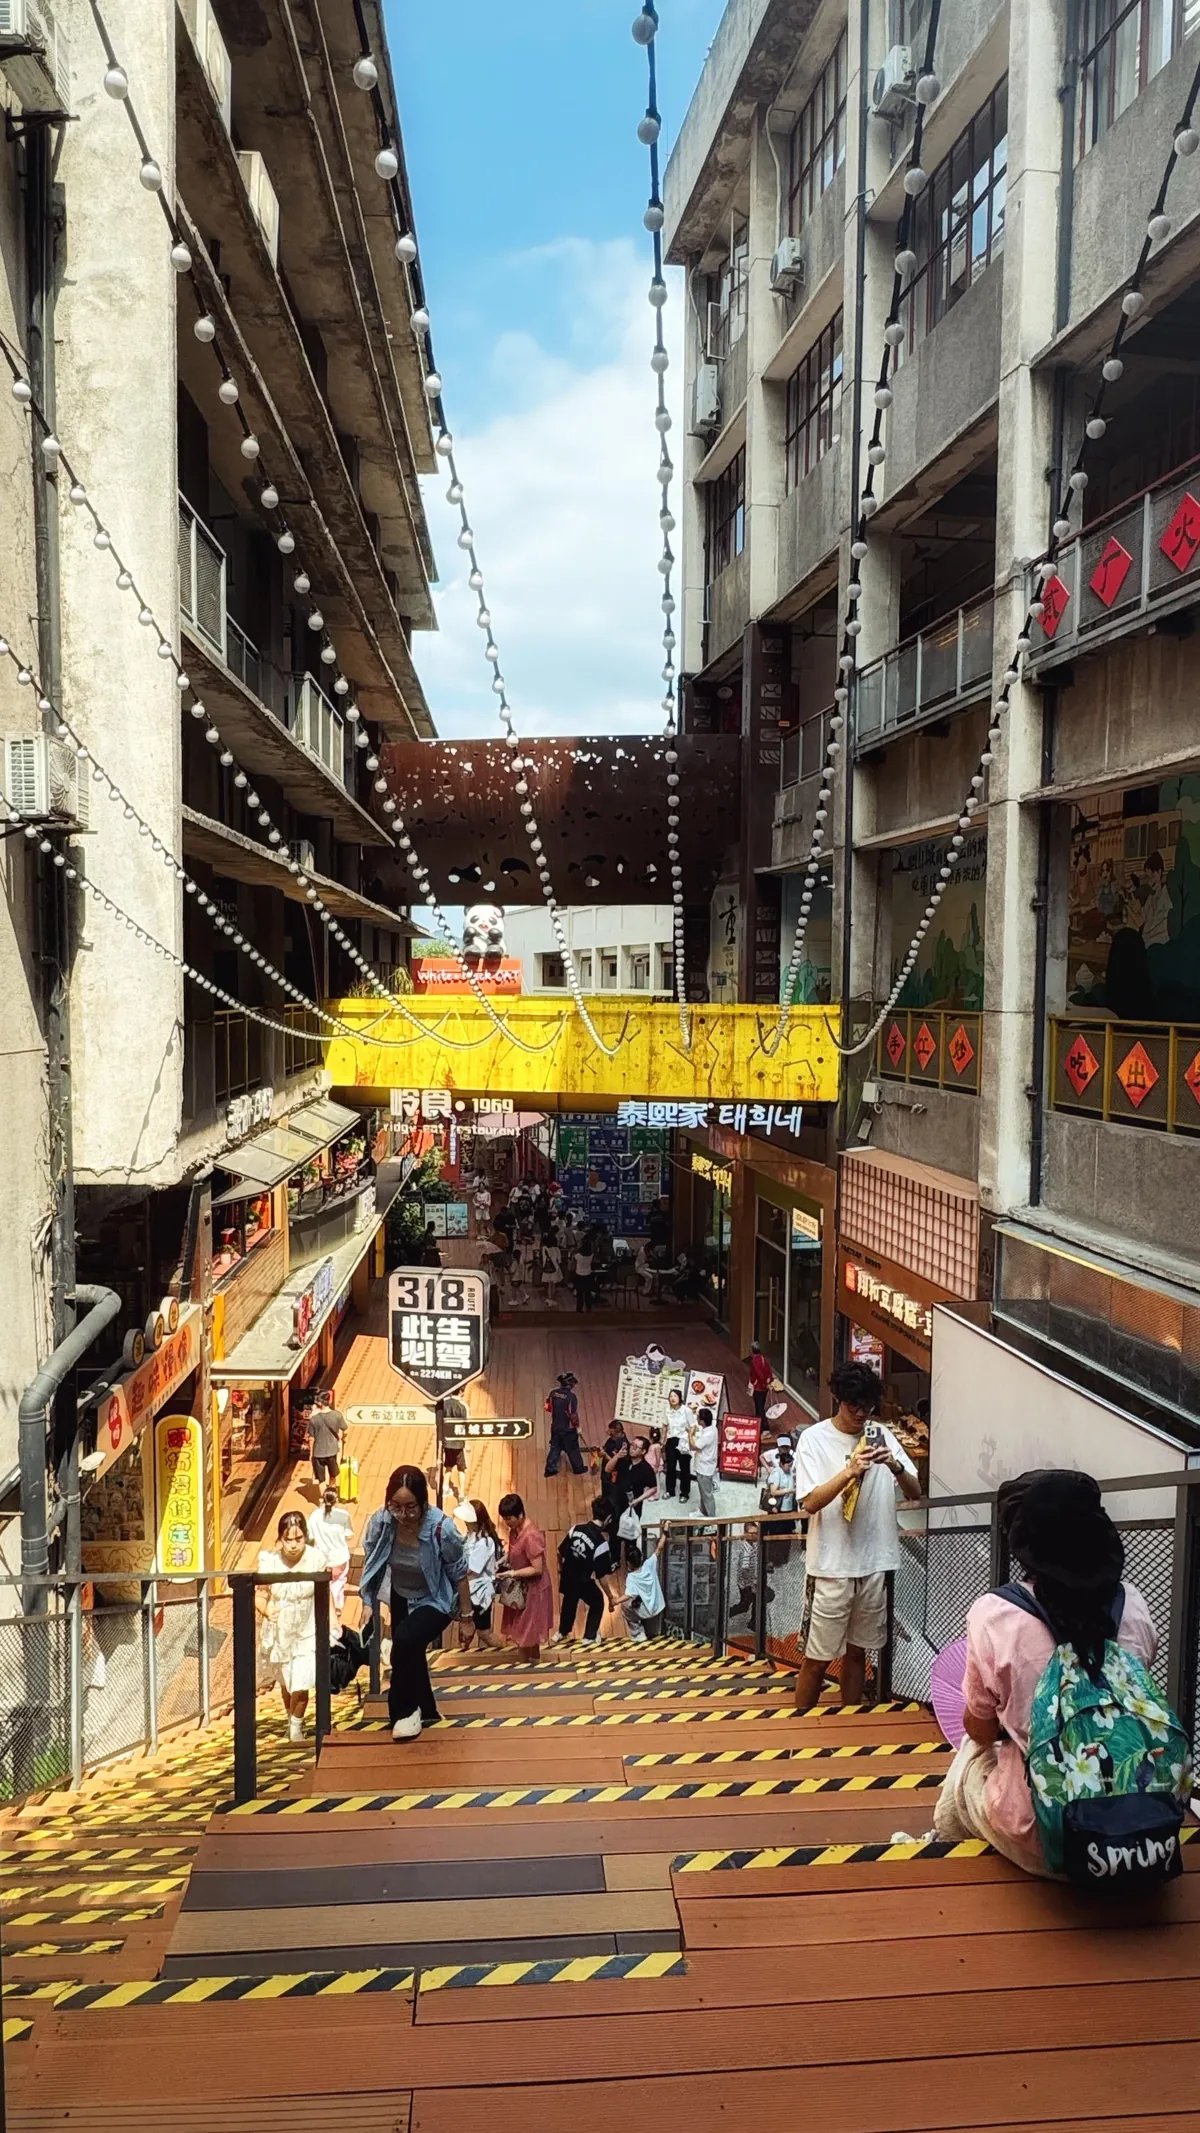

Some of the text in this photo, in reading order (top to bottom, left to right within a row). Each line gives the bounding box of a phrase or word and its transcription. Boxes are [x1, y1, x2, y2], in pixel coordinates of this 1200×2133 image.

[1101, 550, 1122, 595] 厂
[1171, 513, 1197, 557] 火
[1070, 1051, 1147, 1090] 吃 出
[472, 1098, 514, 1114] 1969
[617, 1100, 803, 1138] 泰熙家 태희네
[398, 1276, 464, 1311] 318
[467, 1287, 476, 1313] ROUTE
[401, 1314, 471, 1342] 此生
[401, 1340, 471, 1369] 必驾
[420, 1369, 452, 1380] 2274KM
[370, 1410, 418, 1422] 布达拉宫
[454, 1423, 508, 1436] 稻城亚丁
[1087, 1836, 1176, 1878] Spring
